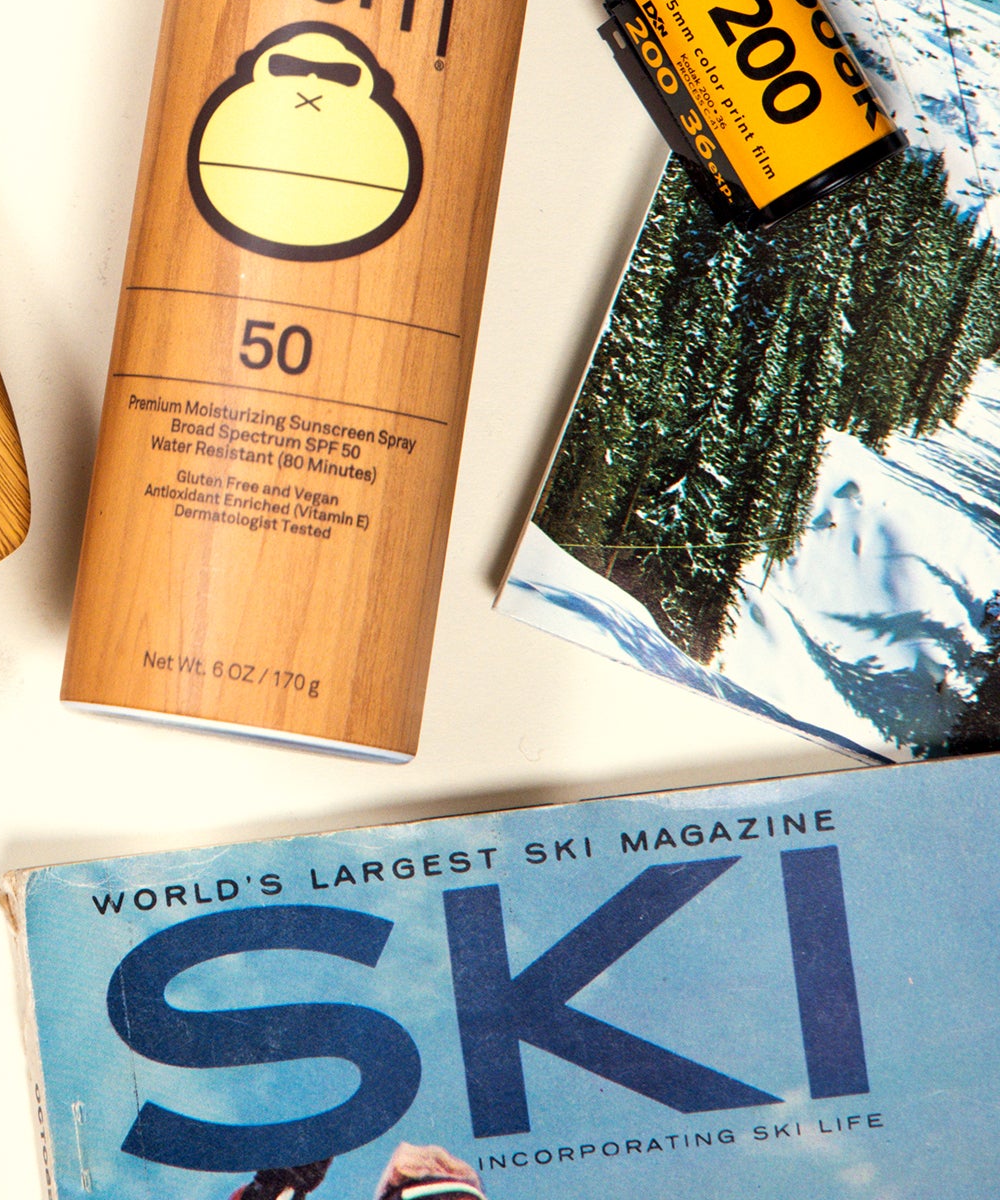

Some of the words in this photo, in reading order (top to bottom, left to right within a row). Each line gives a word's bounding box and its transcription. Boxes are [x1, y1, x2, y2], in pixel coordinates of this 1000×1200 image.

[624, 15, 682, 97] 200
[675, 60, 705, 106] PROCESS
[679, 52, 702, 86] Kodak
[698, 85, 715, 108] 200
[715, 115, 727, 130] 36
[692, 46, 726, 93] color
[720, 96, 755, 142] print
[750, 144, 776, 180] film
[240, 319, 312, 375] 50
[128, 392, 182, 416] Premium
[185, 399, 287, 431] Moisturizing
[288, 414, 376, 442] Sunscreen
[376, 429, 417, 454] Spray
[170, 417, 214, 437] Broad
[217, 424, 302, 452] Spectrum
[304, 437, 339, 455] SPF
[340, 443, 361, 459] 50
[150, 434, 192, 454] Water
[194, 440, 274, 465] Resistant
[276, 452, 304, 473] (80
[306, 457, 377, 484] Minutes)
[144, 482, 220, 506] Antioxidant
[223, 493, 290, 515] Enriched
[292, 503, 354, 526] (Vitamin
[355, 515, 370, 531] E)
[176, 469, 223, 488] Gluten
[225, 476, 259, 493] Free
[261, 481, 291, 498] and
[292, 486, 339, 508] Vegan
[173, 503, 277, 533] Dermatologist
[279, 519, 331, 540] Tested
[142, 650, 174, 671] Net
[176, 655, 207, 676] Wt.
[211, 660, 224, 678] 6
[227, 662, 255, 683] OZ
[272, 670, 306, 690] 170
[307, 679, 320, 698] g
[91, 873, 283, 915] WORLD'S
[310, 847, 498, 888] LARGEST
[524, 837, 591, 865] SKI
[619, 809, 835, 853] MAGAZINE
[107, 845, 869, 1172] SKI
[477, 1128, 735, 1171] INCORPORATING
[752, 1121, 800, 1140] SKI
[818, 1112, 882, 1133] LIFE
